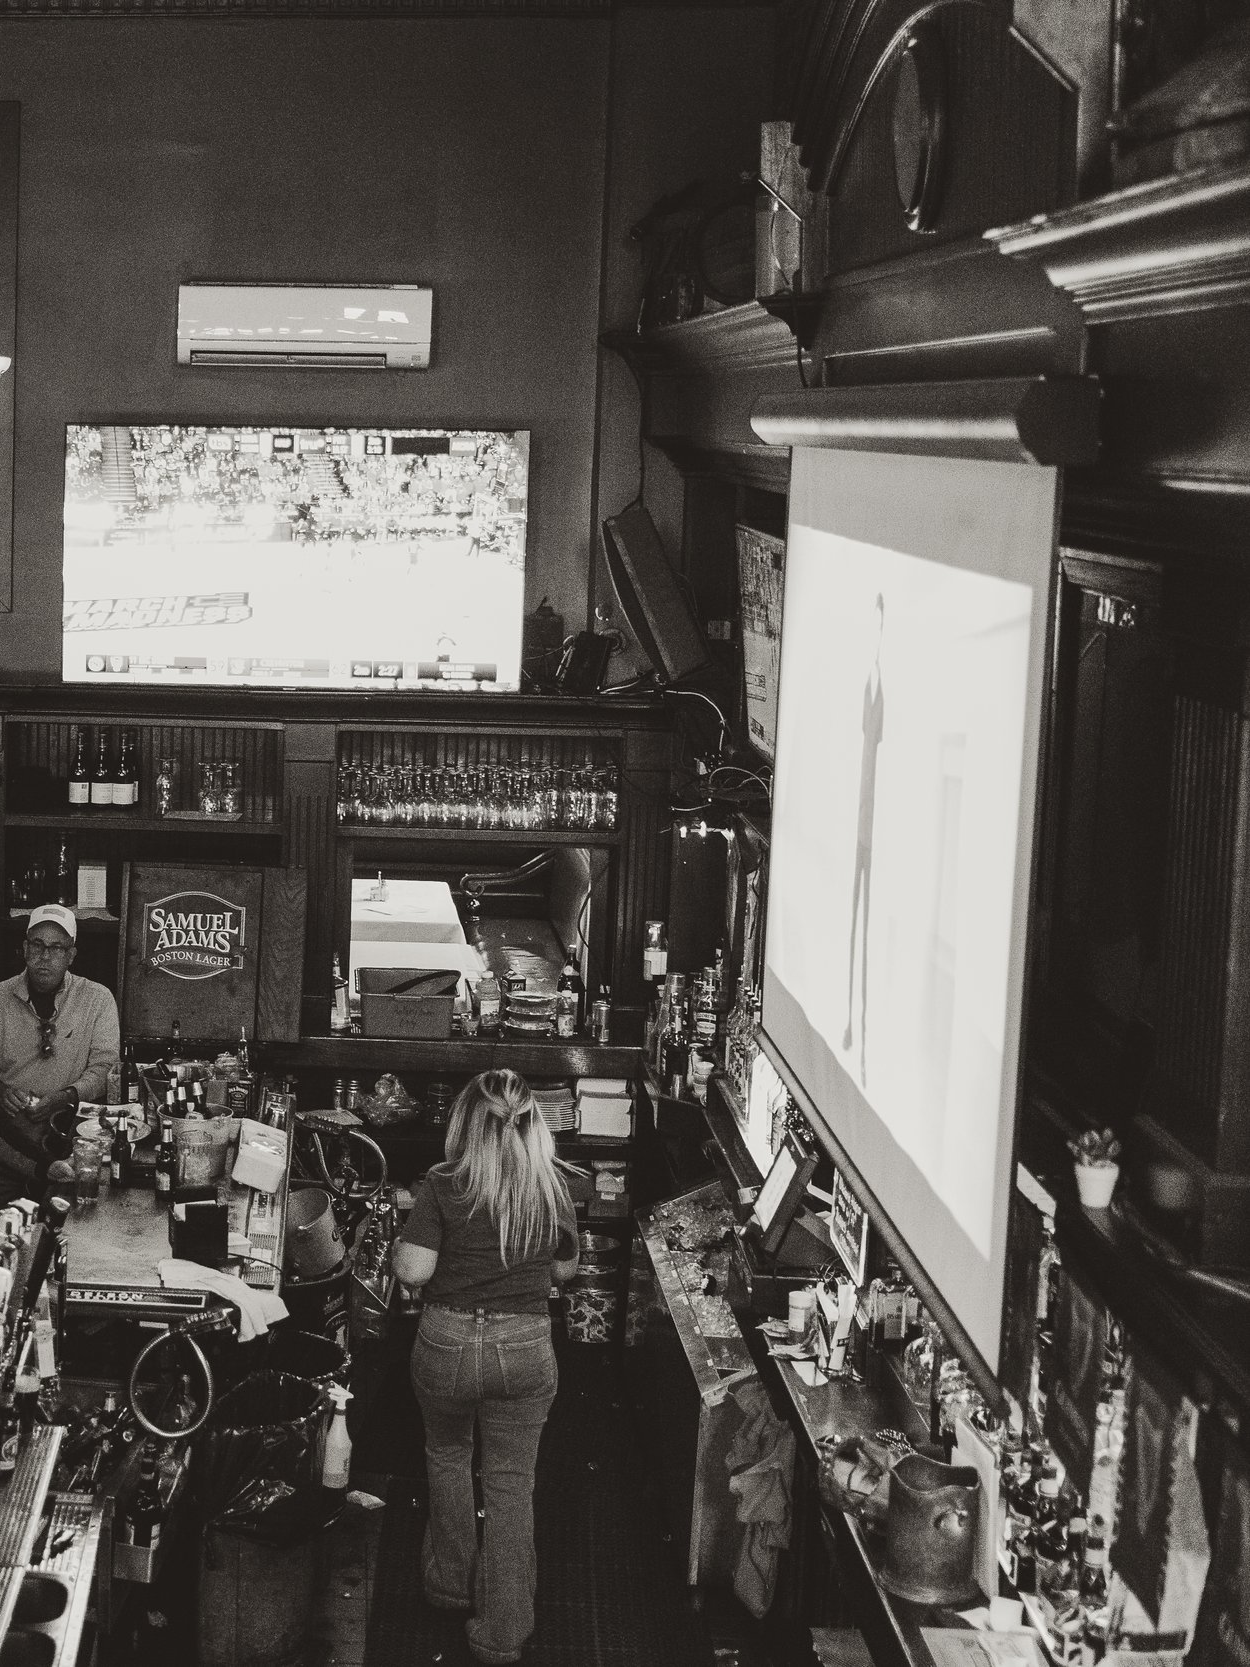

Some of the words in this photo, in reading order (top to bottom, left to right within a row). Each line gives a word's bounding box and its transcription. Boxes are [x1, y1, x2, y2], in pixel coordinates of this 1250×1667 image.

[149, 908, 239, 935] SAMUEL
[153, 929, 231, 953] ADAMS
[150, 950, 194, 967] BOSTON
[195, 953, 232, 967] LAGER
